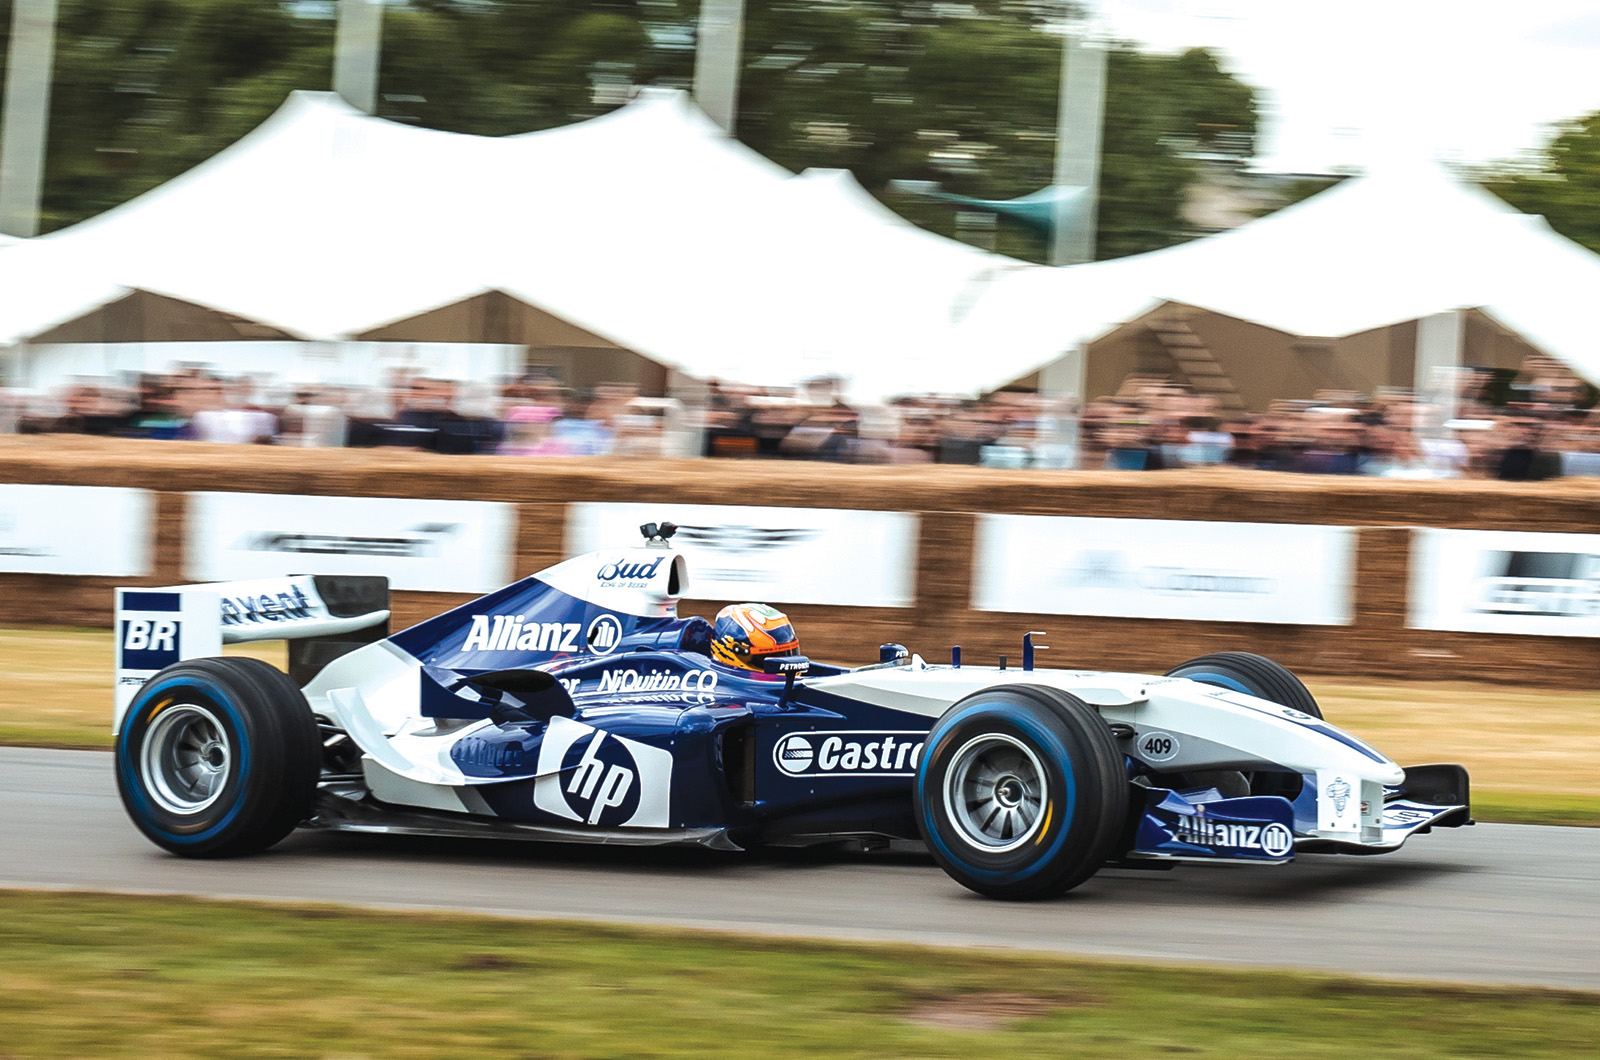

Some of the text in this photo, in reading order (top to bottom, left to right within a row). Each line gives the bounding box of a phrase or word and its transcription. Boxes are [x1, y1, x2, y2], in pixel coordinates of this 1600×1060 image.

[597, 557, 665, 581] Bud
[124, 620, 177, 651] BR
[461, 615, 582, 652] Allianz
[1144, 738, 1172, 755] 409
[567, 729, 634, 825] hp
[1178, 814, 1262, 849] Allianz
